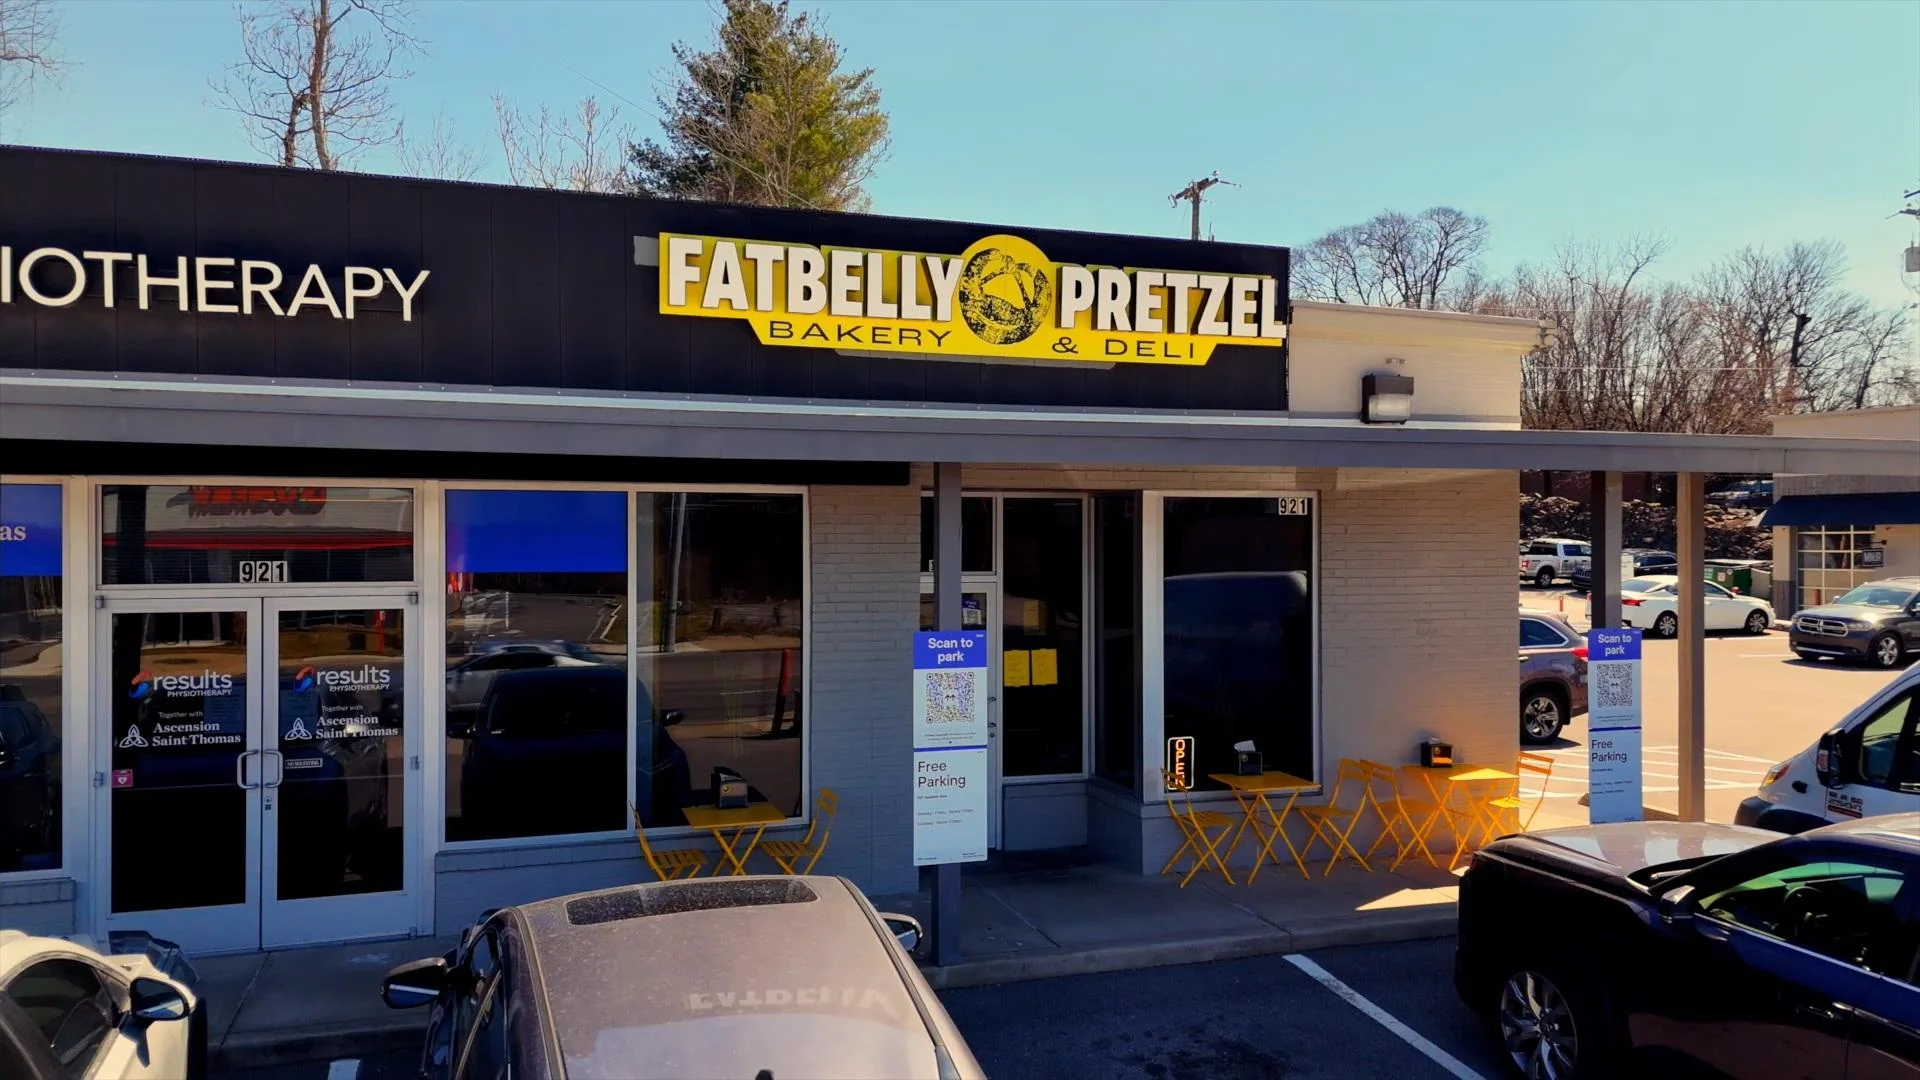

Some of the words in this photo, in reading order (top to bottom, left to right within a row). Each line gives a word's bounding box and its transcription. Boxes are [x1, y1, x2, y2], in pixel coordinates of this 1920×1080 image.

[0, 246, 431, 322] IOTHERAPY
[668, 237, 965, 322] FATBELLY
[1060, 265, 1286, 339] PRETZEL
[769, 320, 953, 348] BAKERY
[1051, 336, 1079, 354] &
[1104, 338, 1194, 359] DELI
[1279, 497, 1307, 515] 921
[0, 526, 26, 541] as
[241, 562, 286, 582] 921
[928, 637, 958, 649] Scan
[960, 637, 974, 648] to
[1598, 634, 1620, 643] Scan
[1622, 634, 1632, 643] to
[937, 650, 965, 665] park
[1605, 645, 1625, 657] park
[153, 668, 233, 691] results
[316, 664, 391, 685] results
[167, 689, 233, 698] PHYSIOTHERAPY
[329, 683, 390, 693] PHYSIOTHERAPY
[316, 714, 380, 727] Ascension
[152, 721, 221, 734] Ascension
[315, 728, 348, 739] Saint
[151, 735, 187, 747] Saint
[188, 734, 242, 746] Thomas
[1591, 739, 1613, 750] Free
[1591, 752, 1628, 763] Parking
[917, 761, 947, 772] Free
[917, 775, 967, 789] Parking
